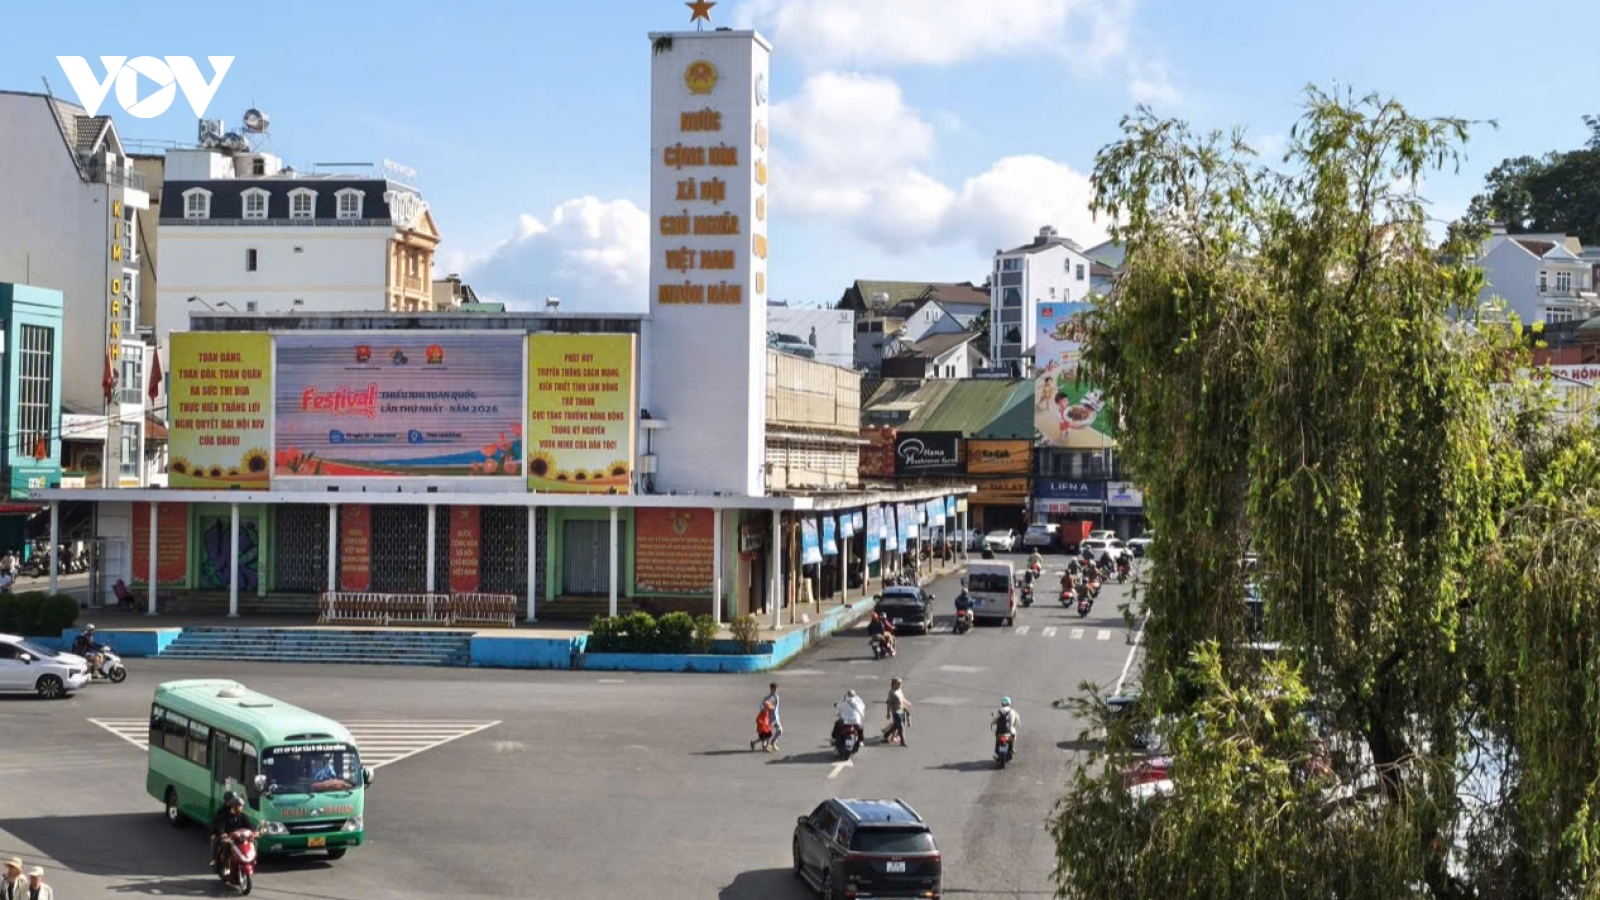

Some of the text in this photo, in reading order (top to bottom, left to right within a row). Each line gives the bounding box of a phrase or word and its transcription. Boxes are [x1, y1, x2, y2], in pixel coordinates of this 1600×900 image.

[677, 177, 725, 205] XÃ HỘI
[112, 200, 121, 261] KIM
[660, 209, 690, 235] CHỦ
[665, 246, 735, 273] VIỆT NAM
[708, 281, 742, 304] NĂM
[110, 278, 121, 361] OANH
[198, 352, 218, 363] TOÀN
[301, 384, 378, 414] Festival
[471, 405, 498, 414] 2026
[906, 453, 939, 464] Mushroom
